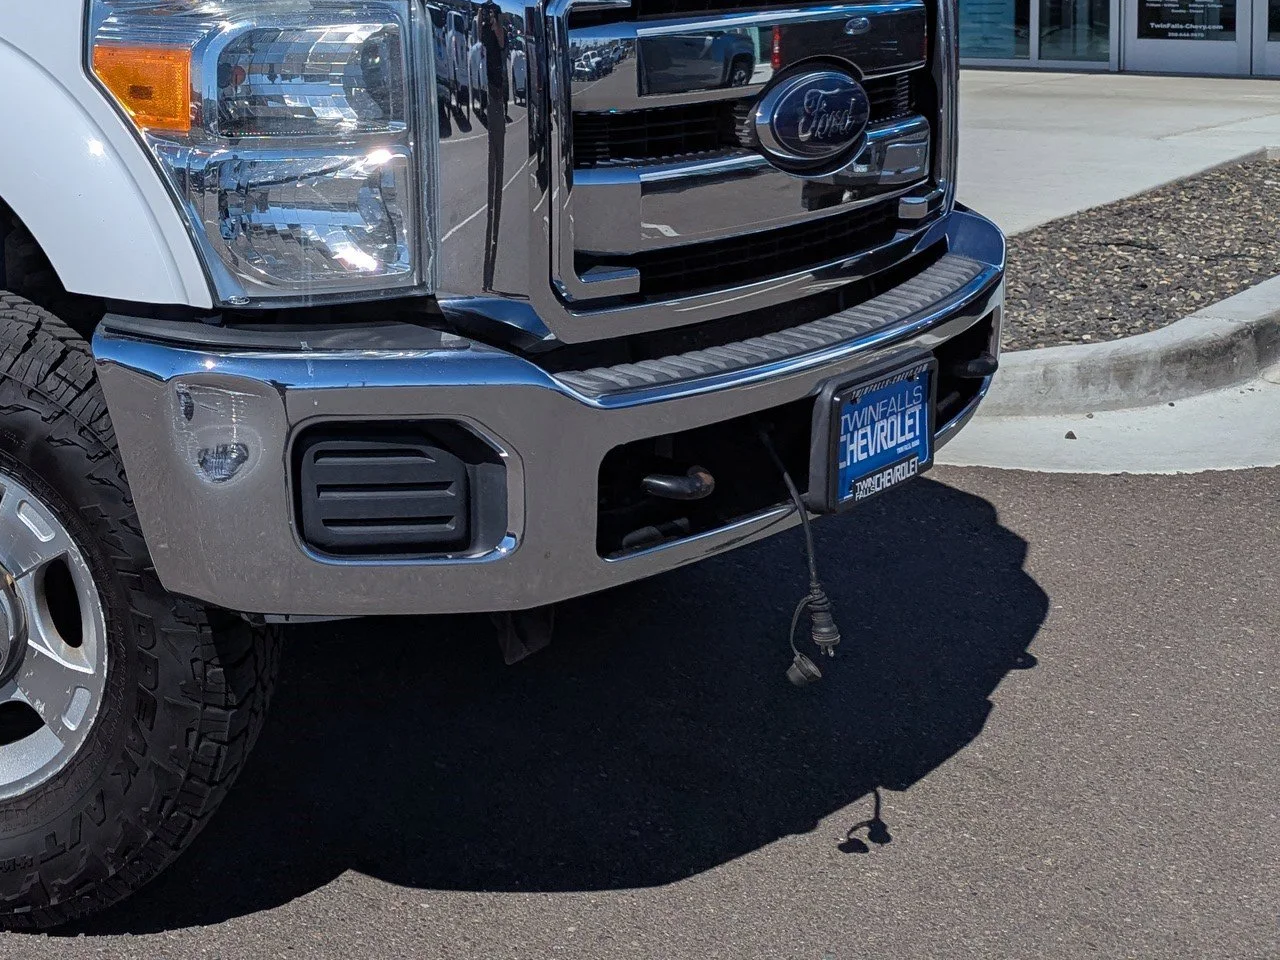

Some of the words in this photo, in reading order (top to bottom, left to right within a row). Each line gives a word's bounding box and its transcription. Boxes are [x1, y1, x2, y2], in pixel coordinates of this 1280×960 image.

[798, 88, 856, 142] Ford
[840, 385, 923, 435] TWINFALLS
[855, 477, 875, 493] TWIN
[874, 456, 919, 491] CHEVROLET
[855, 486, 876, 501] FALLS
